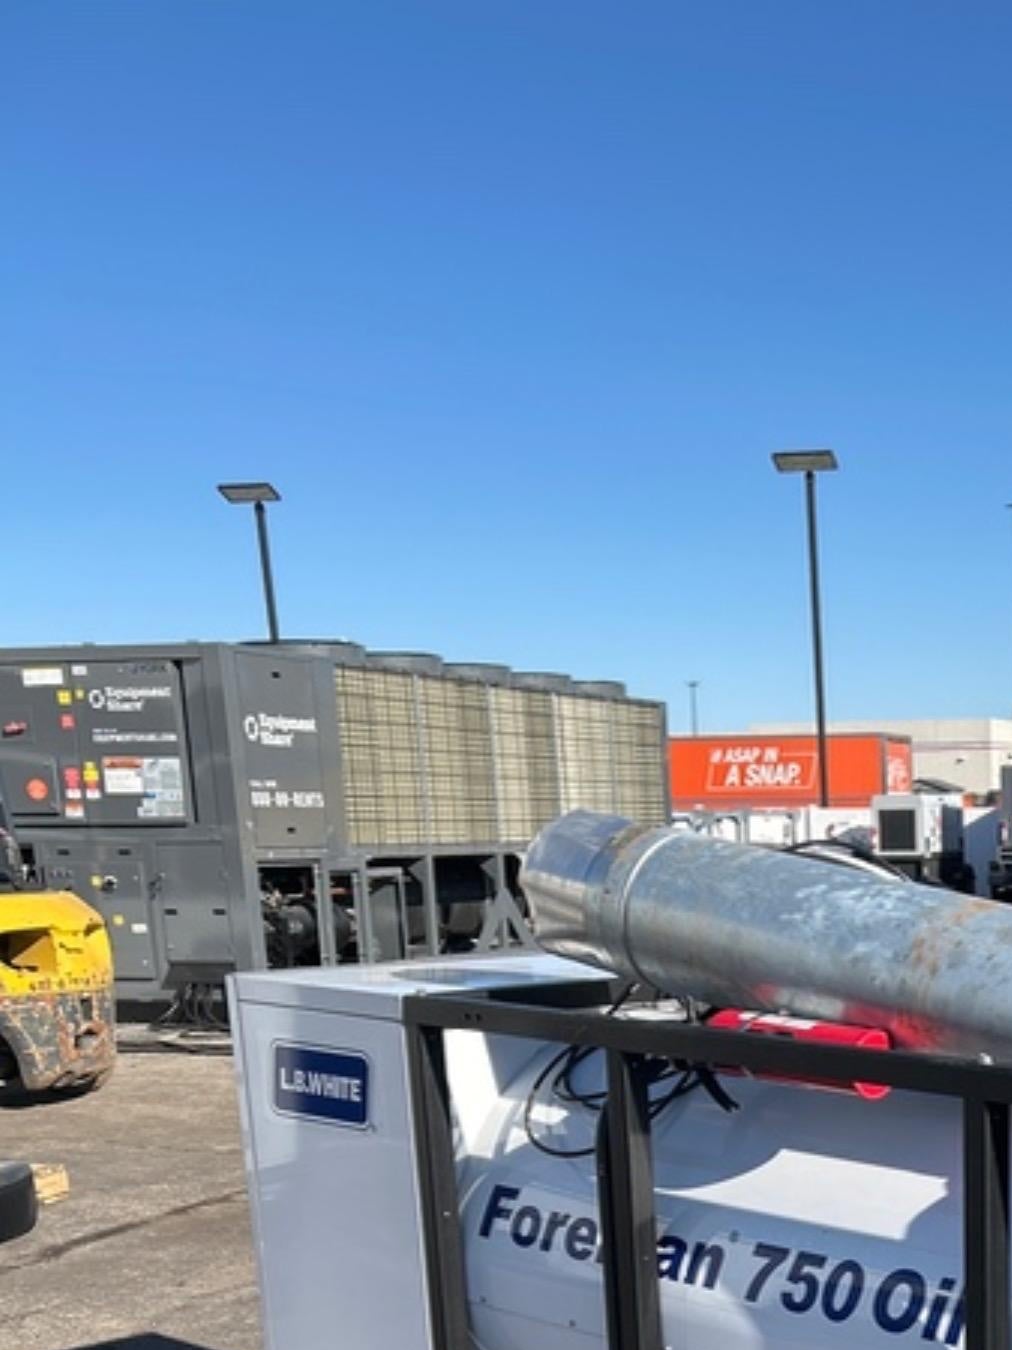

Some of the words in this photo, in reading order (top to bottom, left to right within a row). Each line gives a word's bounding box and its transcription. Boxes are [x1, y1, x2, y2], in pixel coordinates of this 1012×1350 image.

[723, 746, 761, 763] ASAP
[725, 762, 742, 787] A
[478, 1184, 726, 1290] Forean
[745, 1242, 866, 1323] 750
